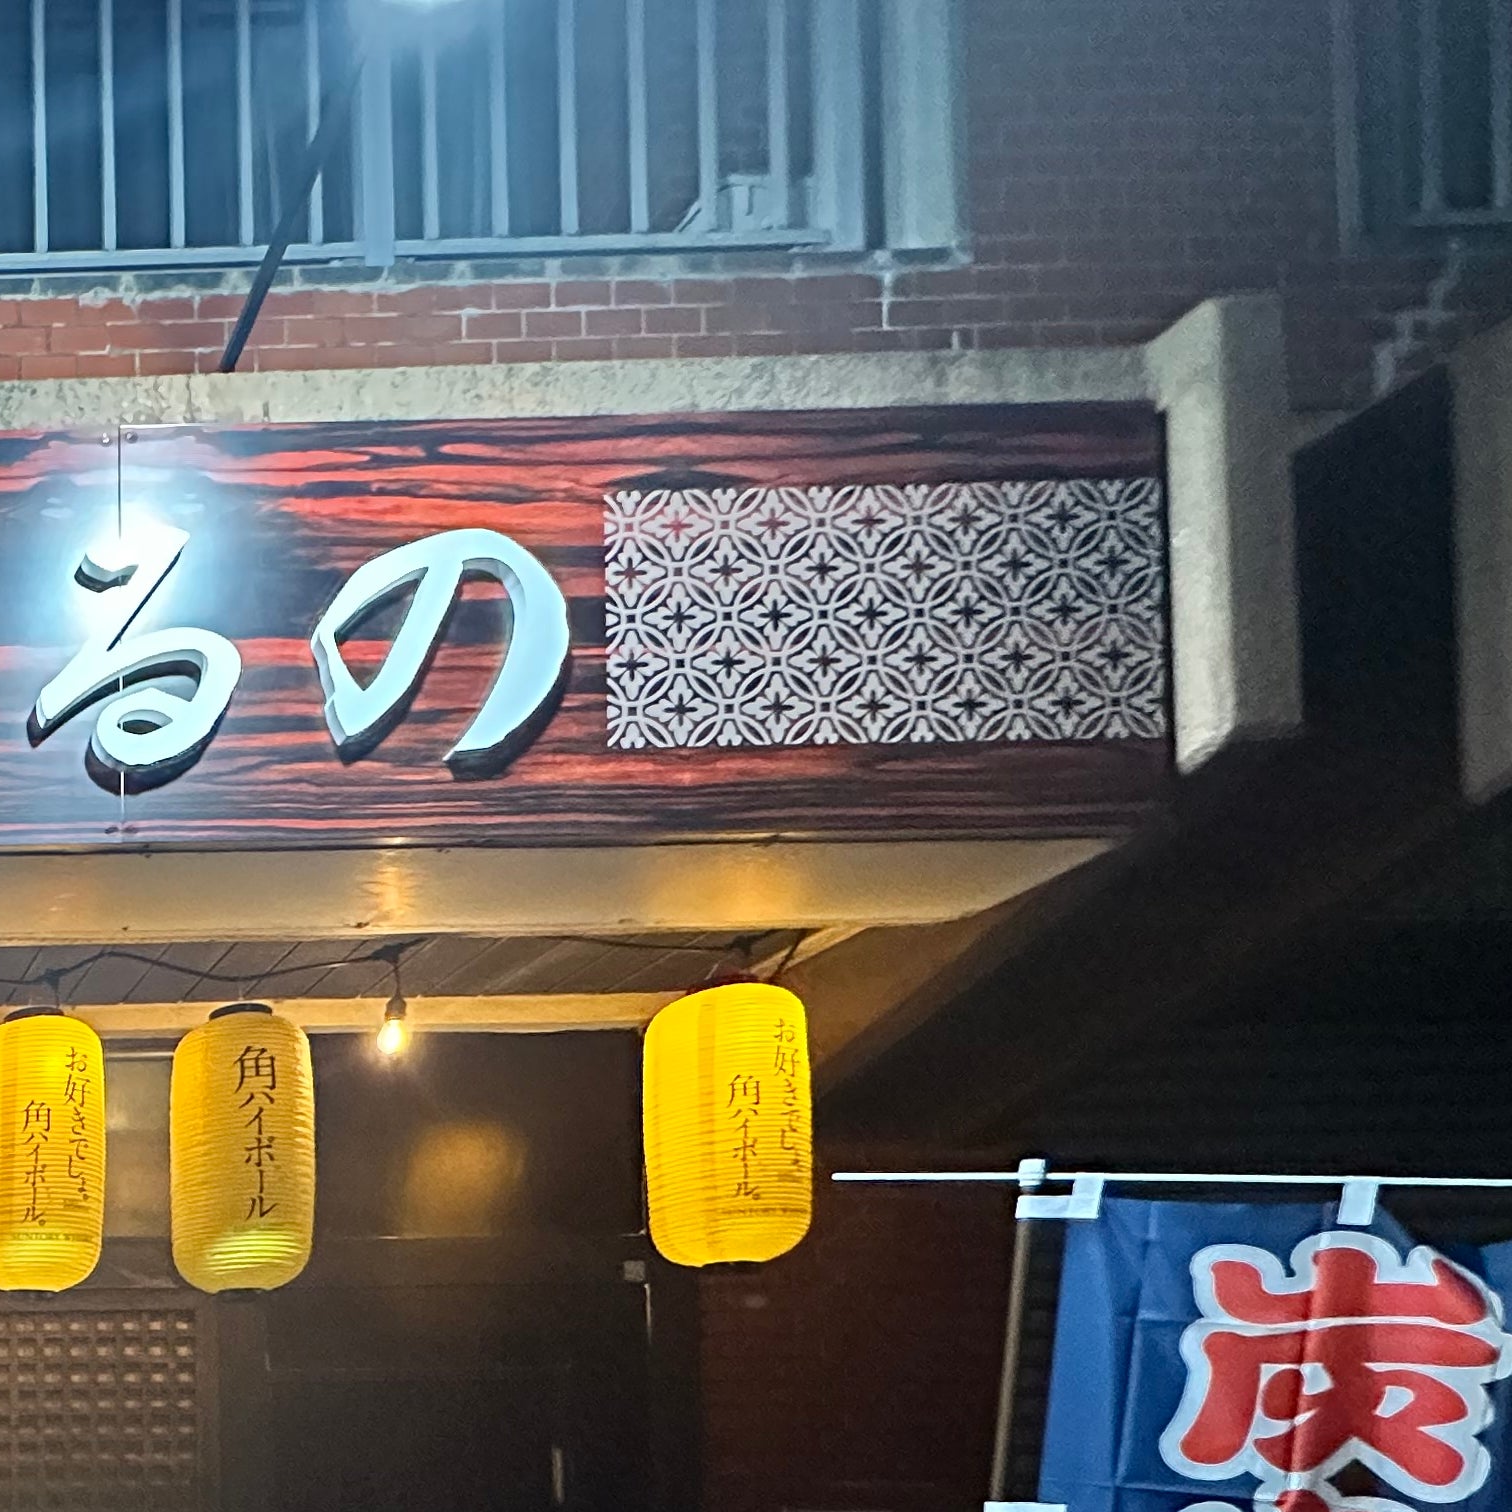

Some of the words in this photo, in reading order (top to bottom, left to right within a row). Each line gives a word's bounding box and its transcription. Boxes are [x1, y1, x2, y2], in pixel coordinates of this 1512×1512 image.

[234, 1045, 279, 1222] 角ハイボール
